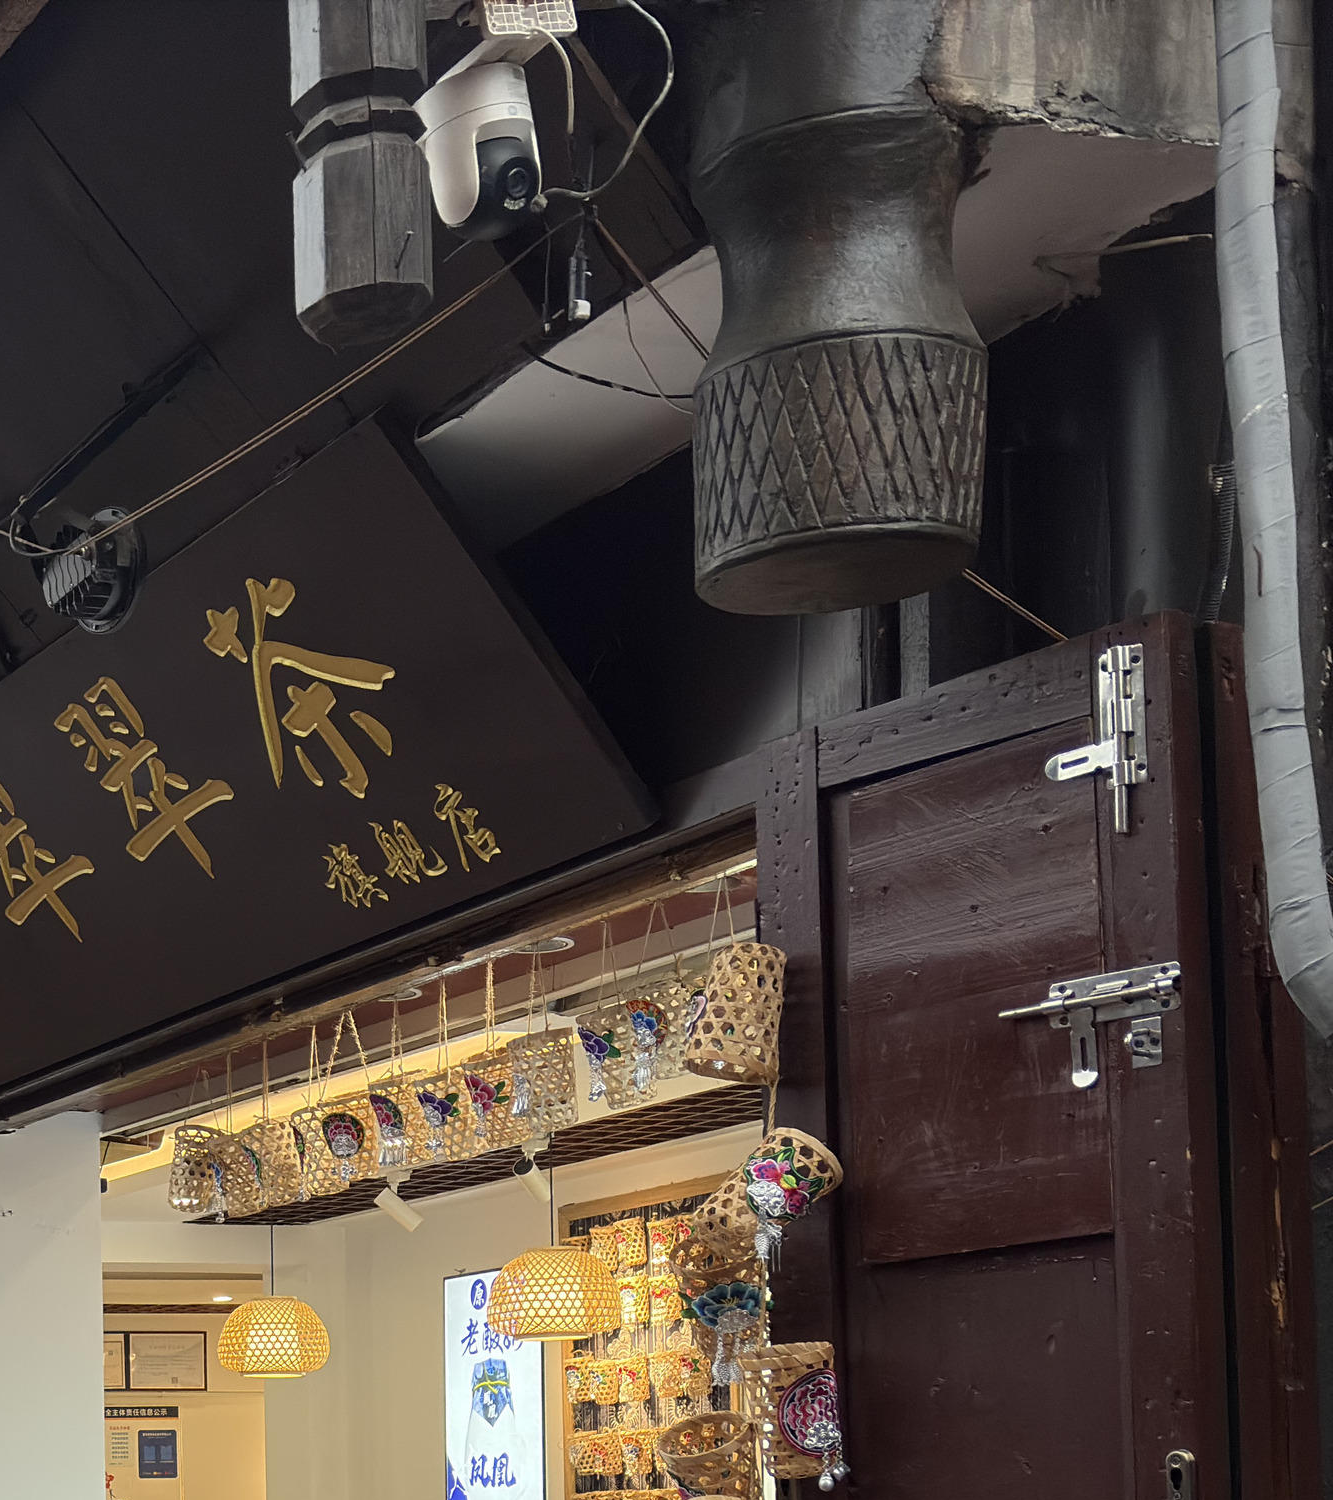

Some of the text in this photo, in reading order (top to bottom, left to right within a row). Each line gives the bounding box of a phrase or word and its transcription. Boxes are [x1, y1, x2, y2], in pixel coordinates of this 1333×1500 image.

[322, 783, 502, 908] 旗舰店
[105, 1408, 168, 1417] 全主体责任信息公示
[469, 1453, 517, 1489] 凤凰
